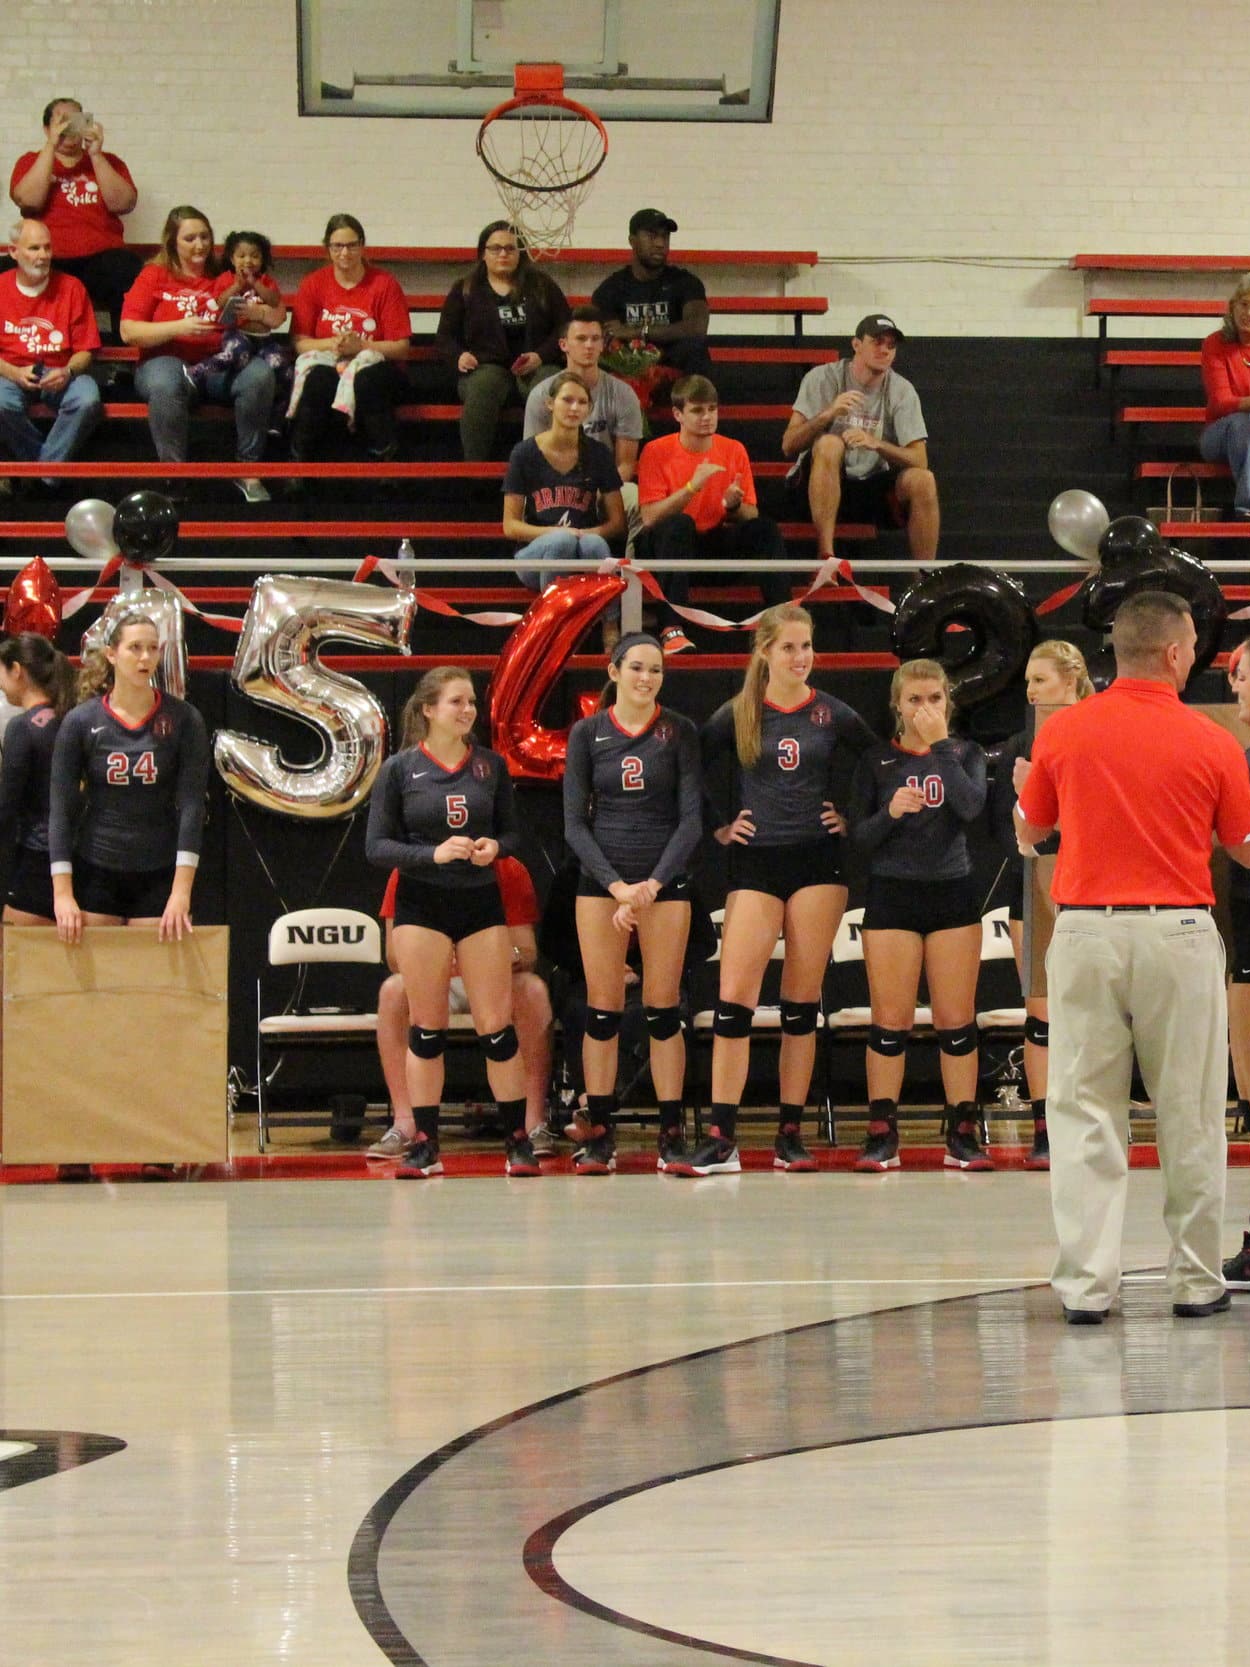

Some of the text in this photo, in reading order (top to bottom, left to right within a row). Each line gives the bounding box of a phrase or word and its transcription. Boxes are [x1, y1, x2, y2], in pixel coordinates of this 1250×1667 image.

[4, 319, 38, 336] Bump
[27, 343, 61, 354] Spike
[107, 751, 159, 785] 24
[778, 738, 800, 770] 3
[621, 756, 645, 790] 2
[446, 795, 469, 828] 5
[286, 925, 366, 945] NGU
